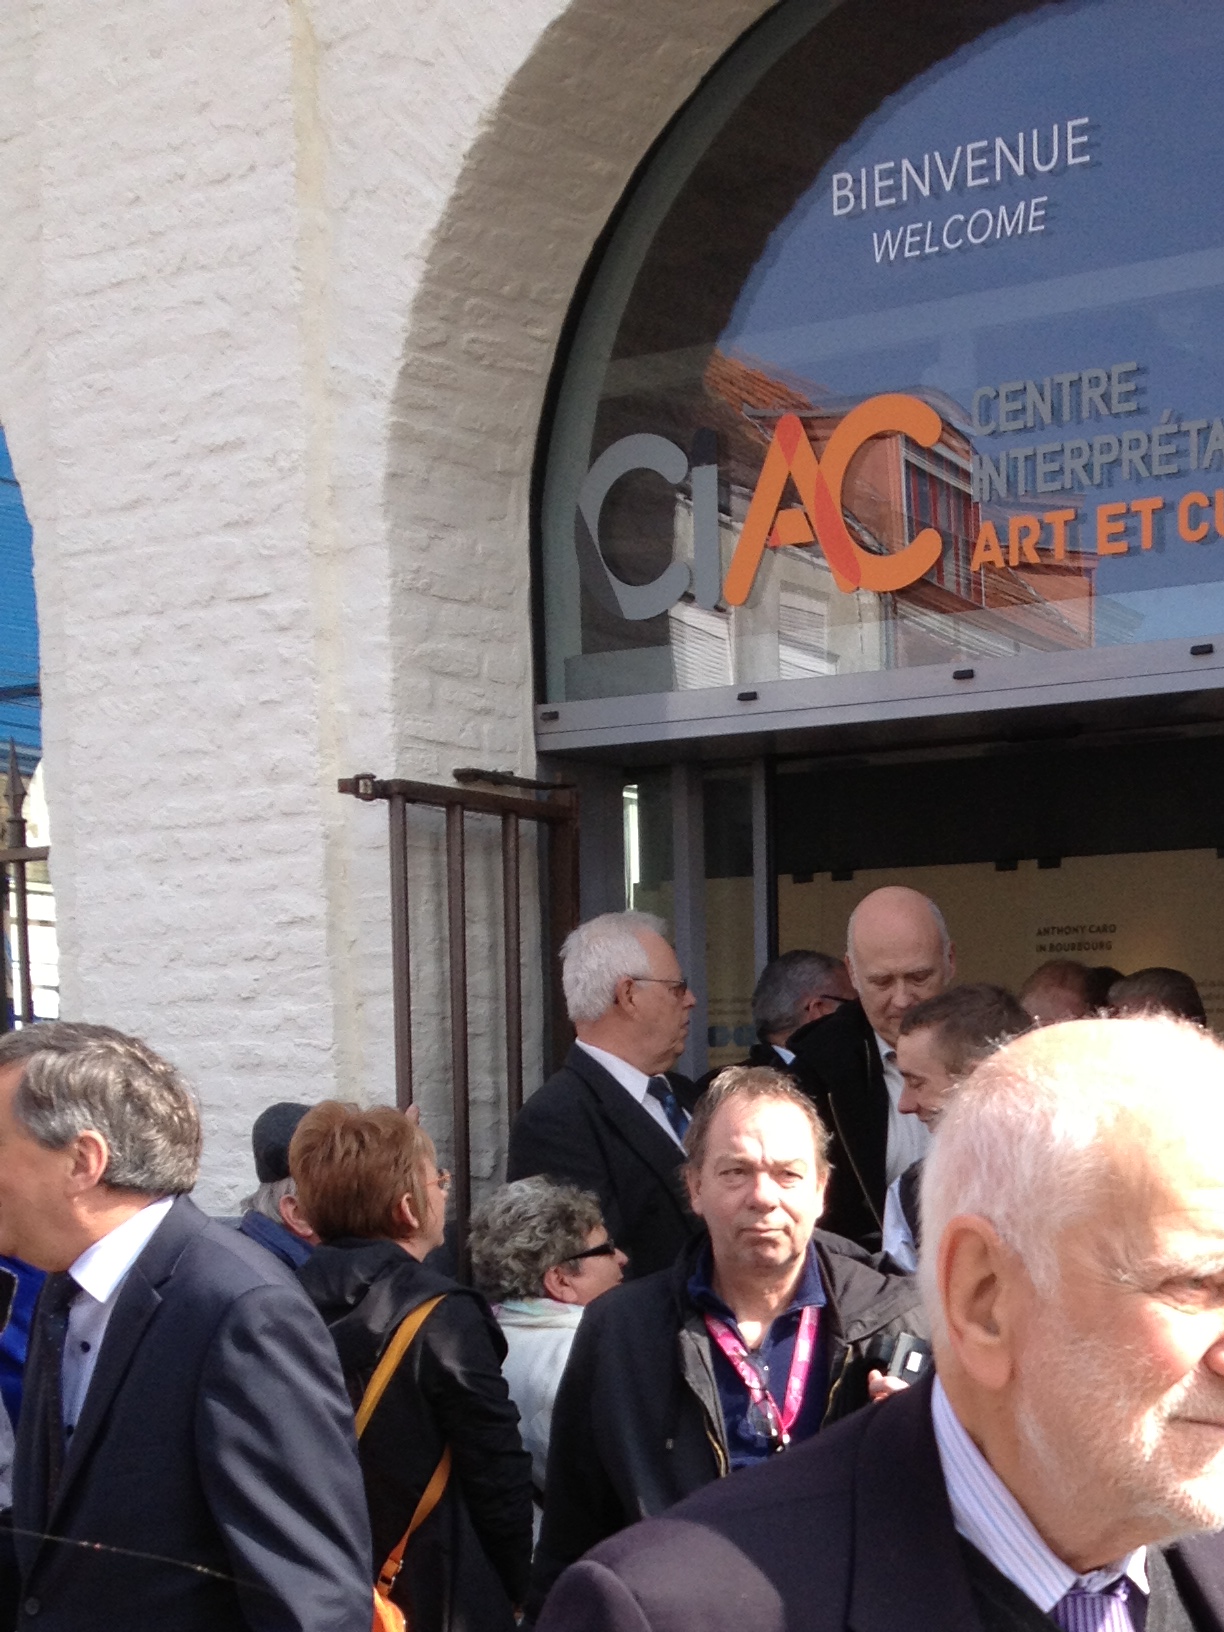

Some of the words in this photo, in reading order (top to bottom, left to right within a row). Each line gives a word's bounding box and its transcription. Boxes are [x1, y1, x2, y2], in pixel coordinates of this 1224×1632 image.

[832, 116, 1091, 217] BIENVENUE
[872, 195, 1048, 264] WELCOME
[970, 360, 1138, 437] CENTRE
[969, 507, 1076, 573] ART
[1096, 495, 1165, 557] ET
